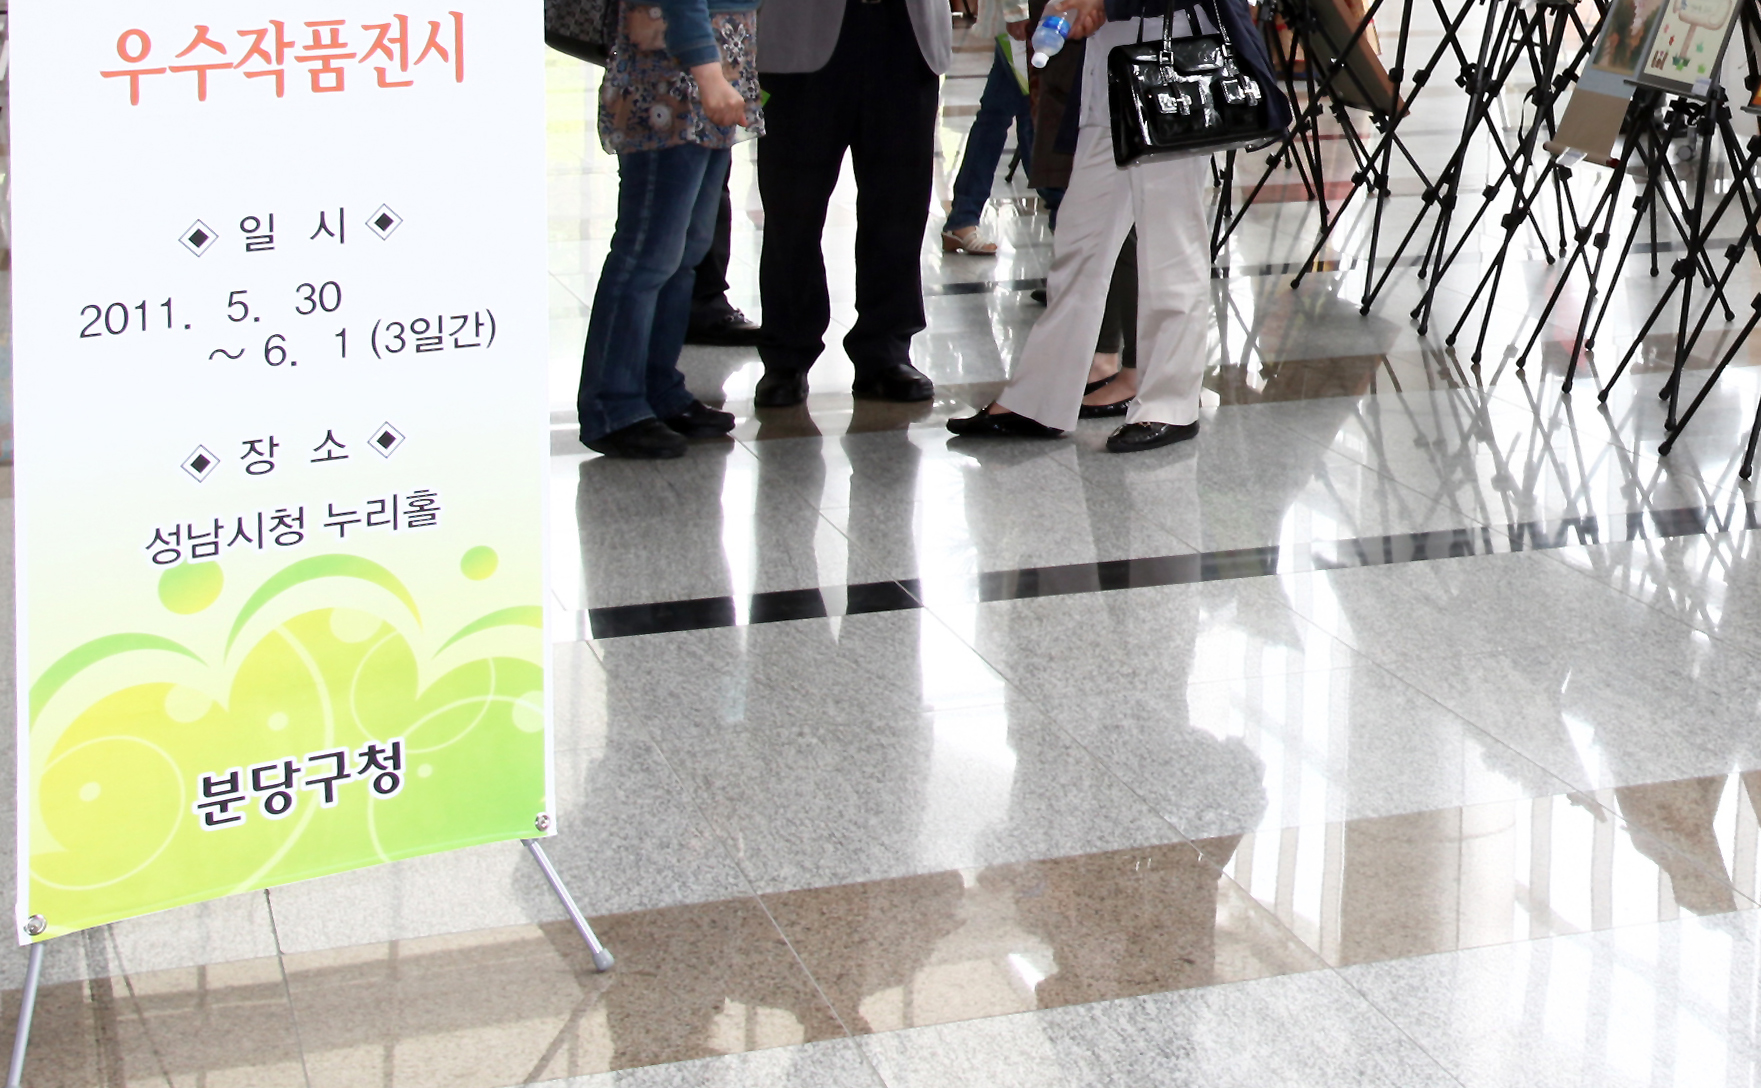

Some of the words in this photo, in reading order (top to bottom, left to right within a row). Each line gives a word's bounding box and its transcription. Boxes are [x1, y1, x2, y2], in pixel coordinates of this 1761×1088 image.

[100, 11, 465, 106] 우수작품전시
[79, 296, 192, 339] 2011.
[227, 289, 261, 323] 5.
[295, 280, 343, 316] 30
[264, 333, 299, 368] 6.
[334, 327, 347, 360] 1
[371, 308, 498, 361] (3일간)
[145, 505, 308, 566] 성남시청
[323, 489, 442, 539] 누리홀
[197, 741, 404, 827] 분당구청
